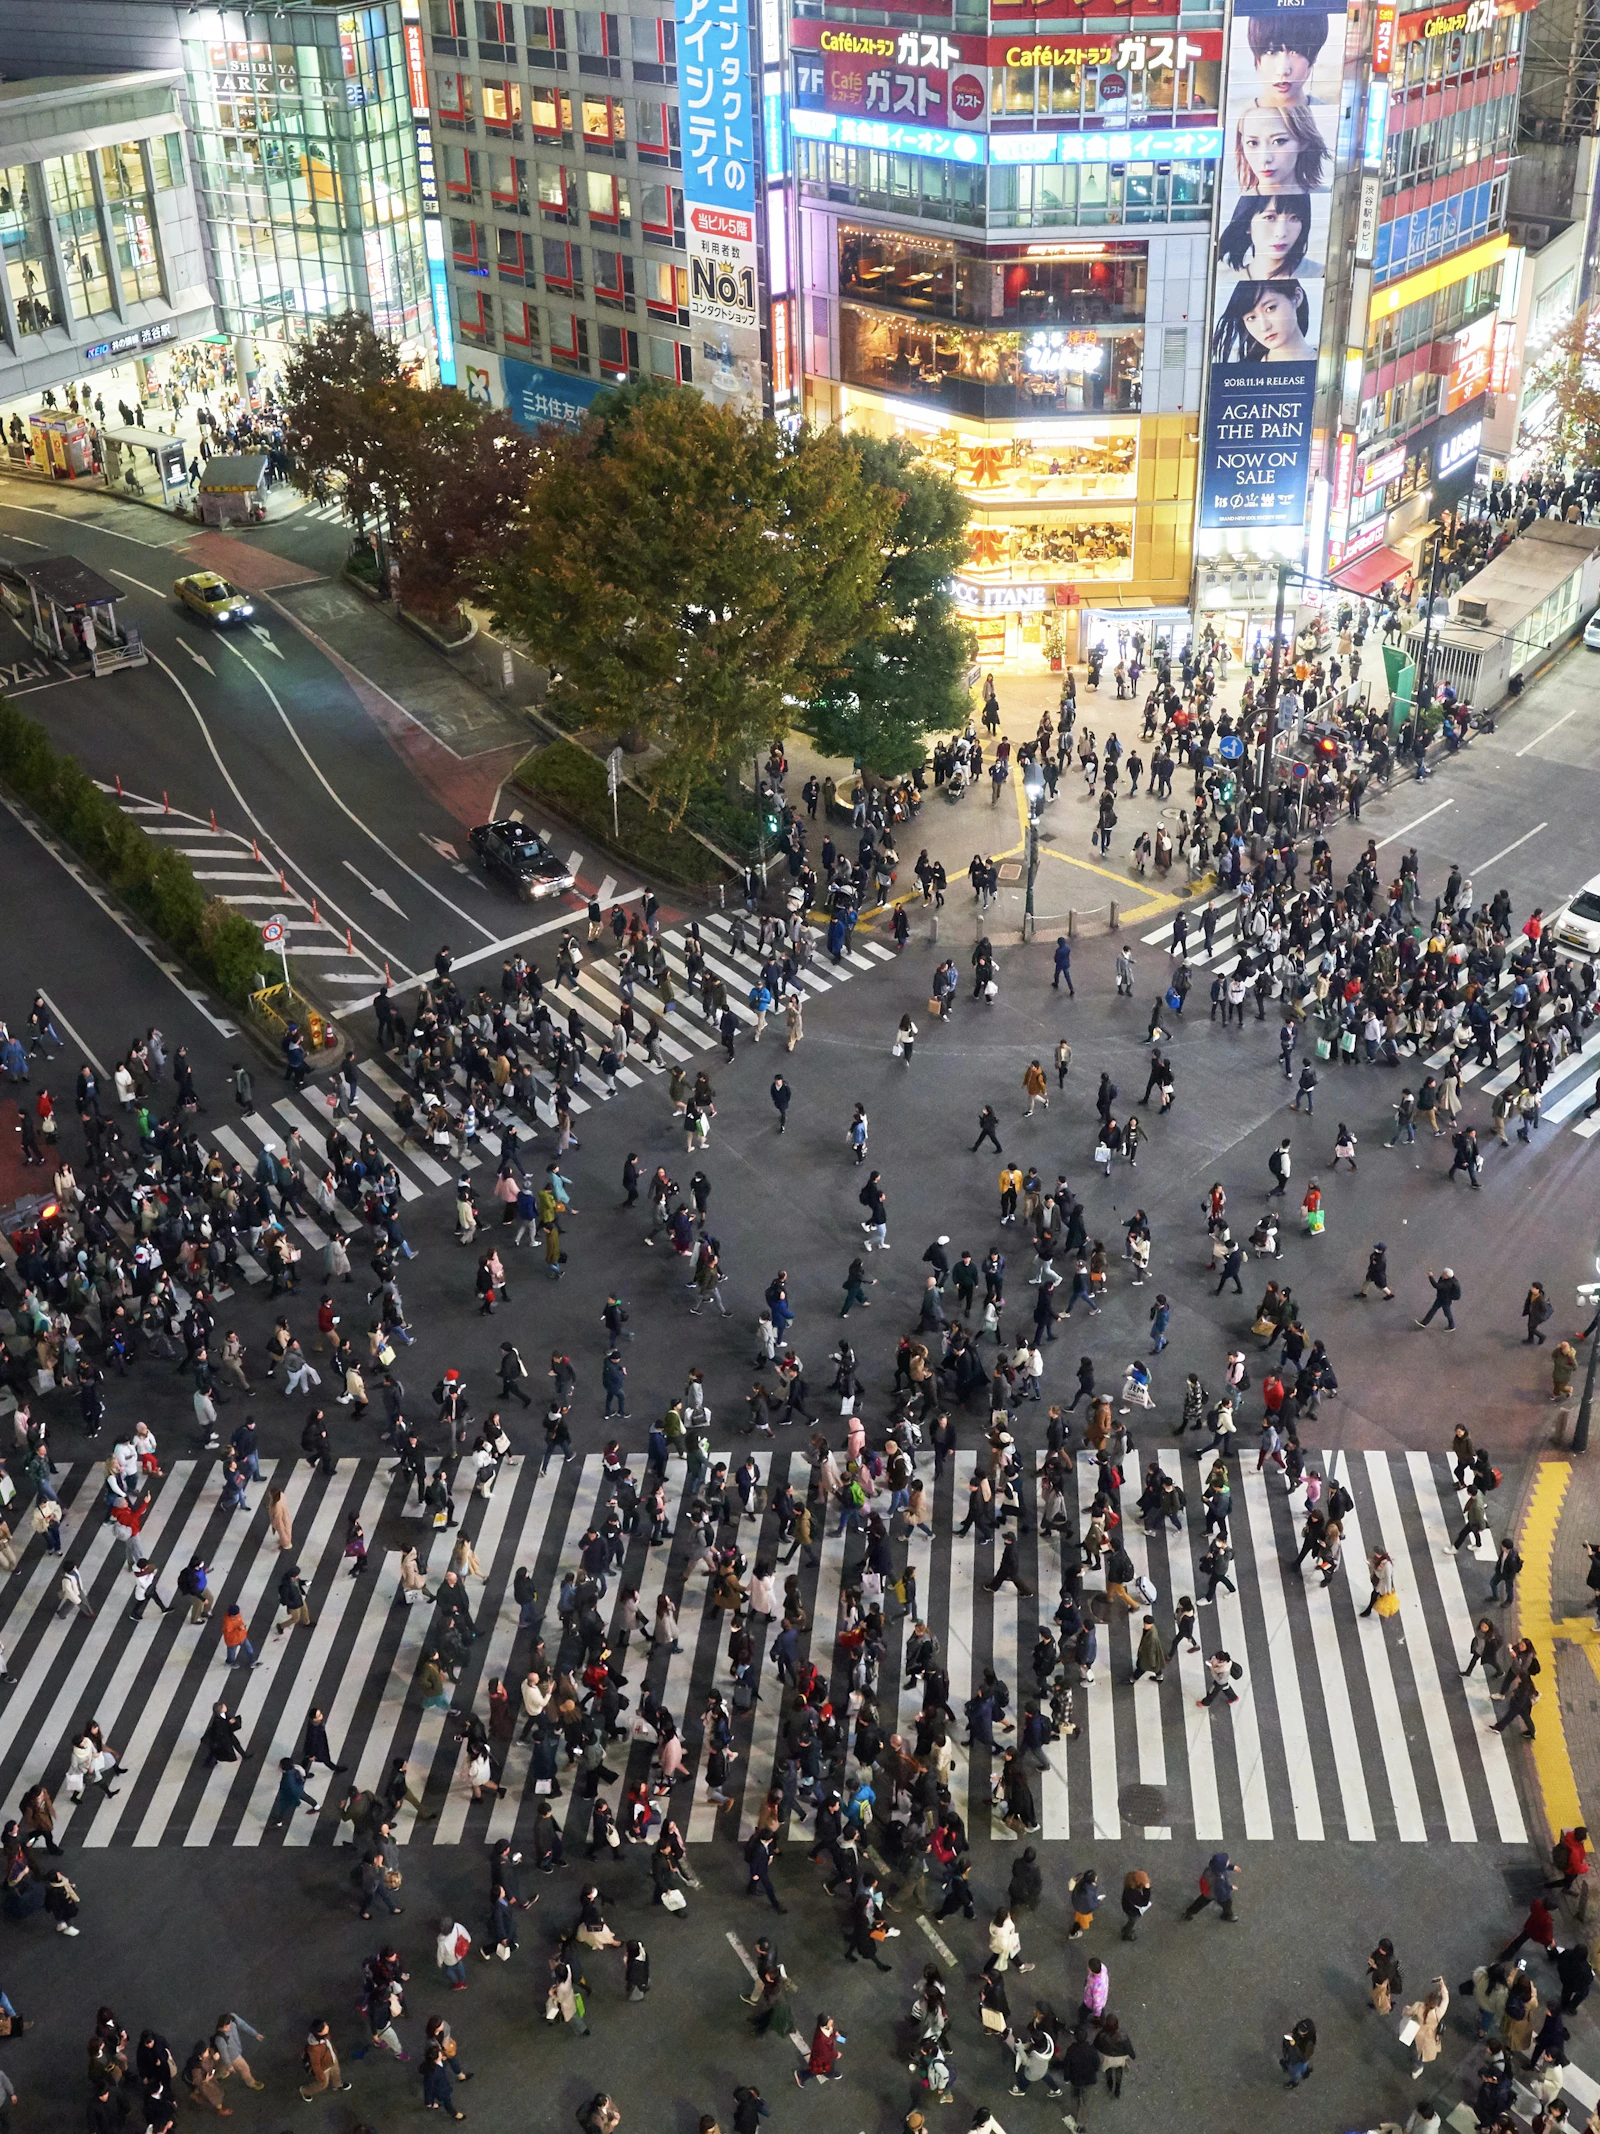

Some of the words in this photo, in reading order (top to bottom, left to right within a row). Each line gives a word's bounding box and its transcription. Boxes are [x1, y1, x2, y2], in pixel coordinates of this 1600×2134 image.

[1464, 0, 1498, 34] ガスト
[897, 32, 960, 69] ガスト
[1377, 21, 1392, 64] ガスト
[1116, 35, 1203, 72] ガスト
[230, 61, 296, 75] SHIBUYA
[279, 78, 337, 96] CTY
[798, 67, 824, 93] 7F
[831, 70, 862, 91] Café
[1102, 85, 1123, 94] ガスト
[866, 70, 941, 116] ガスト
[955, 93, 981, 108] ガスト
[425, 202, 437, 211] 5F
[698, 213, 748, 238] 当ビル5階
[1360, 184, 1375, 252] 渋谷駅前ビル
[701, 240, 741, 259] 利用者数
[692, 302, 756, 326] コンタクトショップ
[141, 324, 171, 343] 渋谷駅
[87, 344, 110, 359] KEIO
[1223, 377, 1264, 387] 2018.11.14
[1266, 376, 1305, 386] RELEASE
[1217, 424, 1254, 440] THE
[1440, 421, 1482, 469] LUSH
[1216, 453, 1265, 469] NOW
[1268, 452, 1297, 467] ON
[1236, 469, 1275, 485] SALE
[1128, 1384, 1145, 1395] JEM
